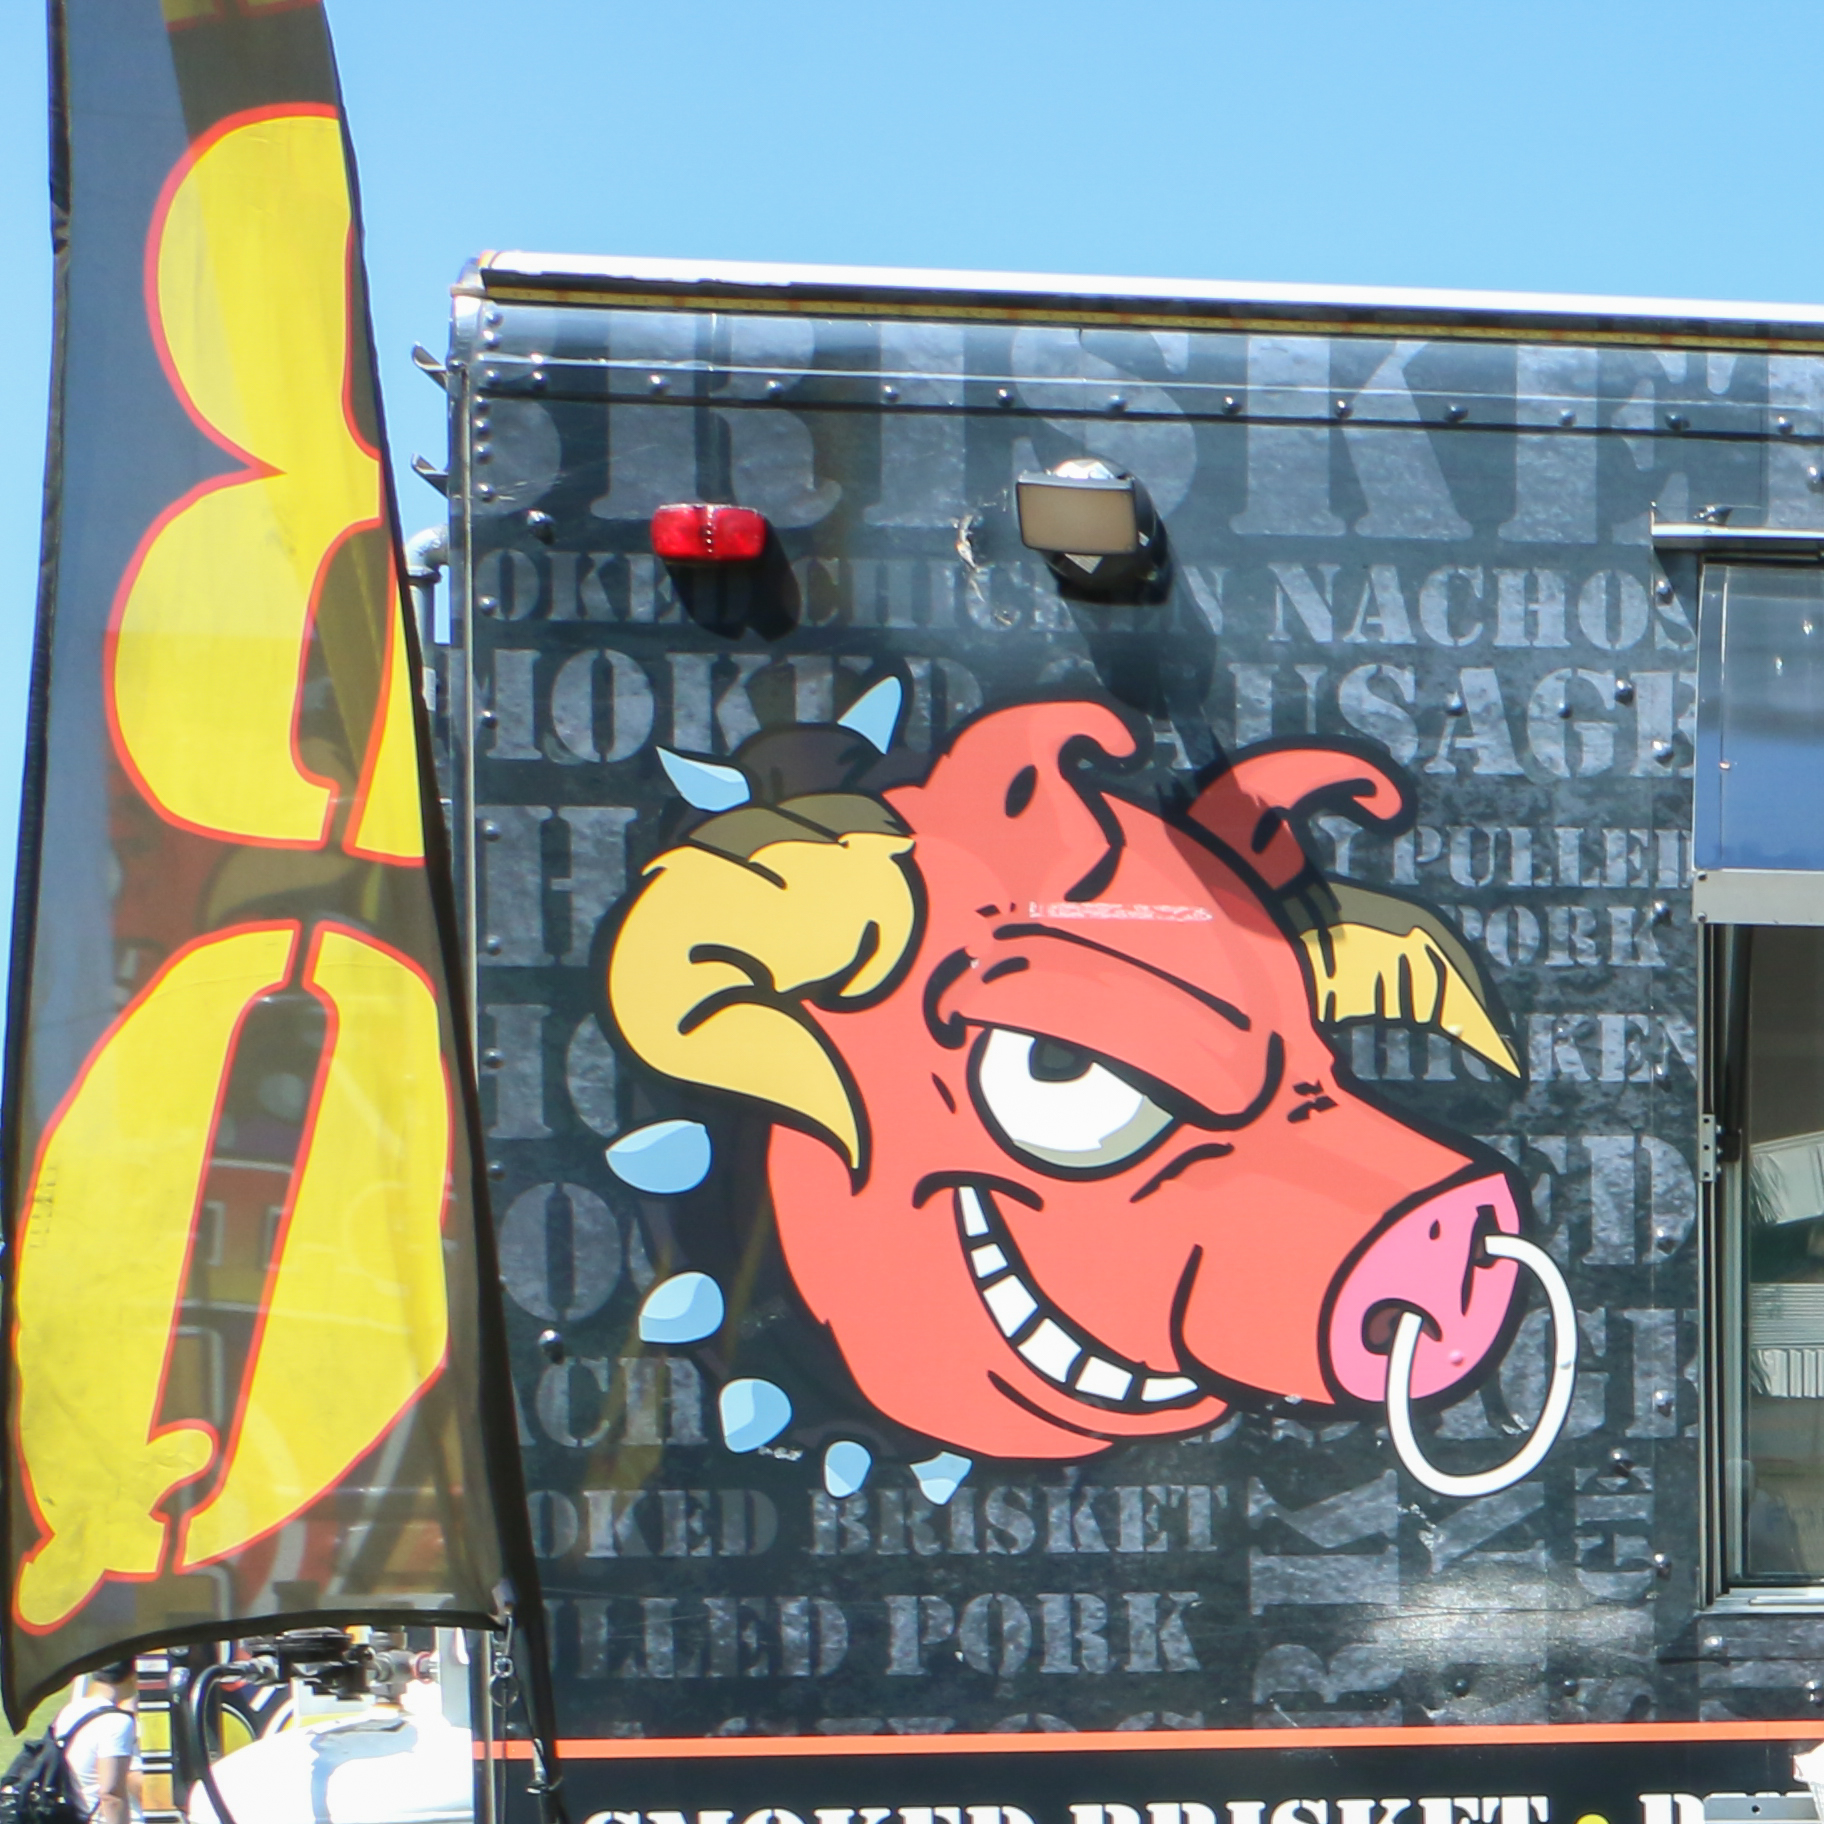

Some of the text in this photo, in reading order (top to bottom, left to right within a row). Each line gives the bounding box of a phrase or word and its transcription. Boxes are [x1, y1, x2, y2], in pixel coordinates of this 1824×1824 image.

[795, 554, 1228, 638] CHICKN
[1266, 562, 1697, 652] NACHOS
[1040, 655, 1697, 782] AUSAGE
[807, 1484, 1229, 1556] BRISKET
[882, 1592, 1202, 1679] PORK
